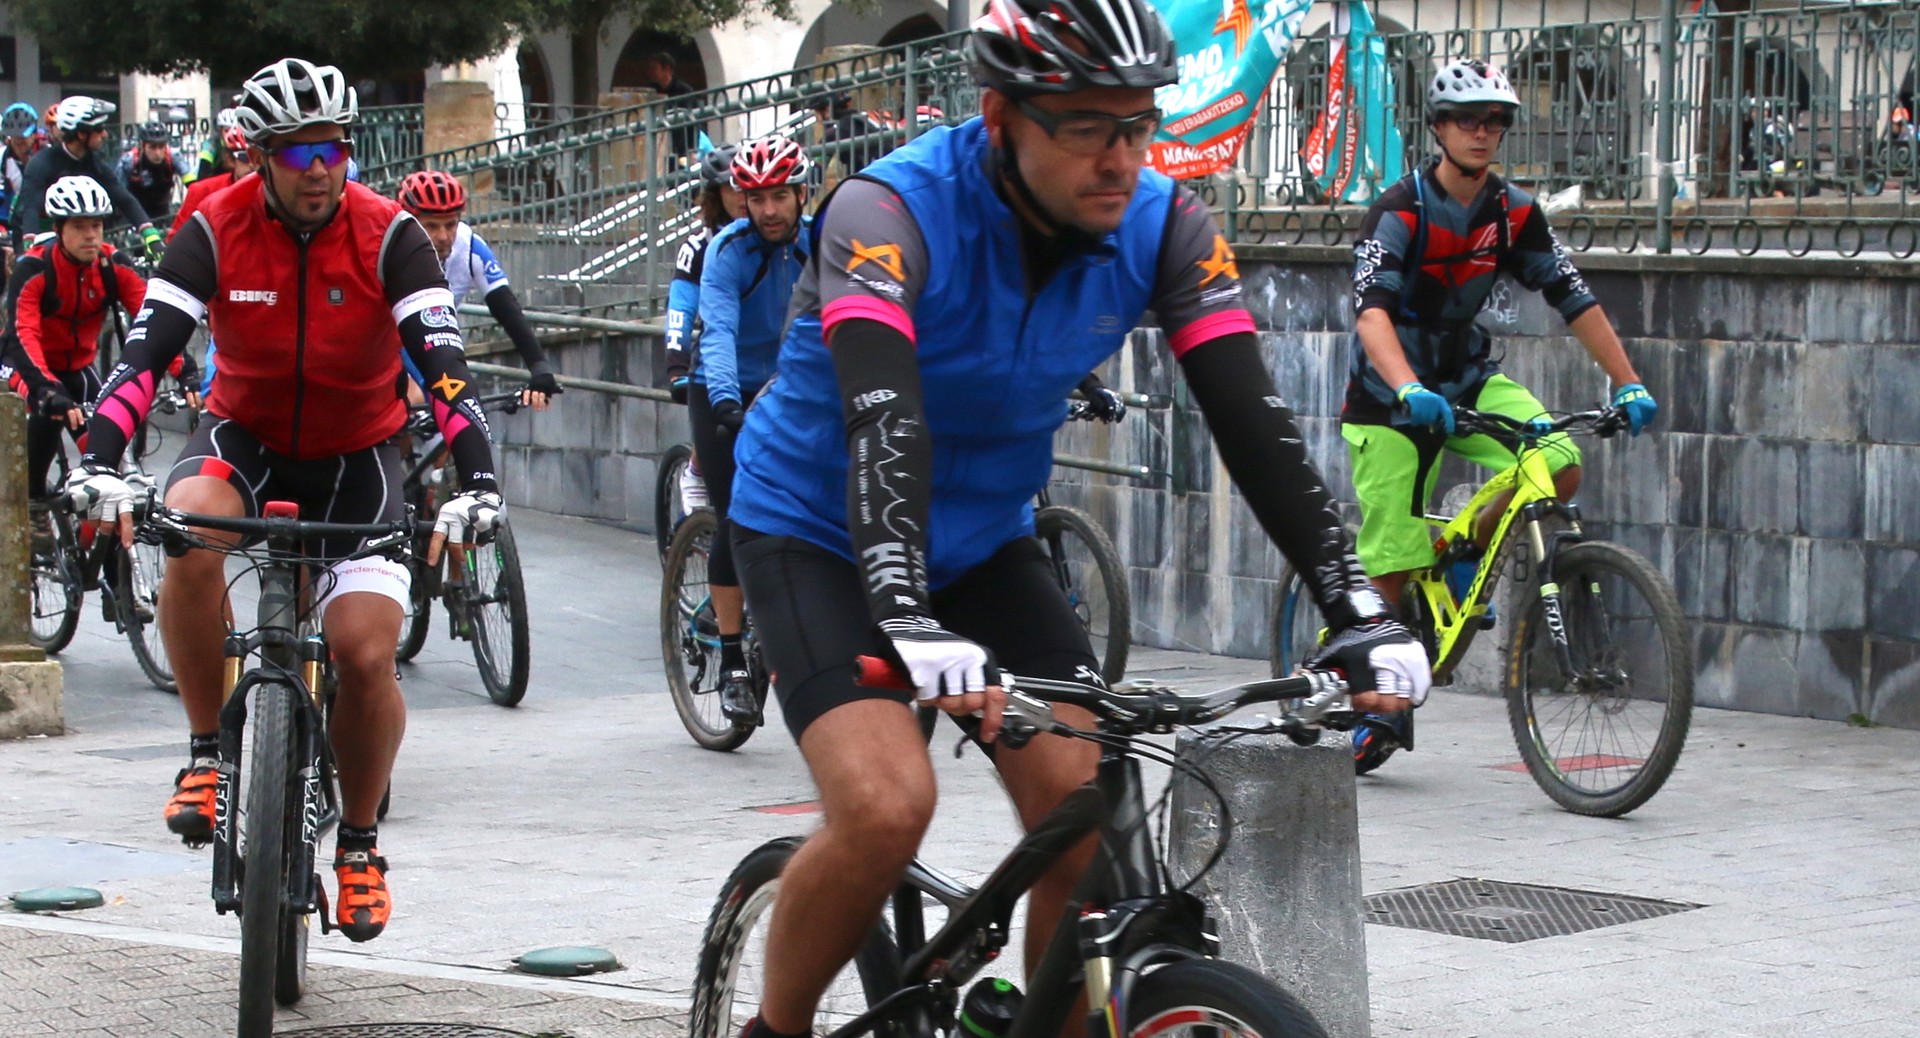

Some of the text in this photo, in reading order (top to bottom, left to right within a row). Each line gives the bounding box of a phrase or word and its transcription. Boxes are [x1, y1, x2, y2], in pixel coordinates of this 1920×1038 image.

[229, 290, 278, 305] BIKE
[1542, 598, 1568, 647] FOX
[214, 780, 231, 843] FOX
[301, 780, 319, 846] FOX
